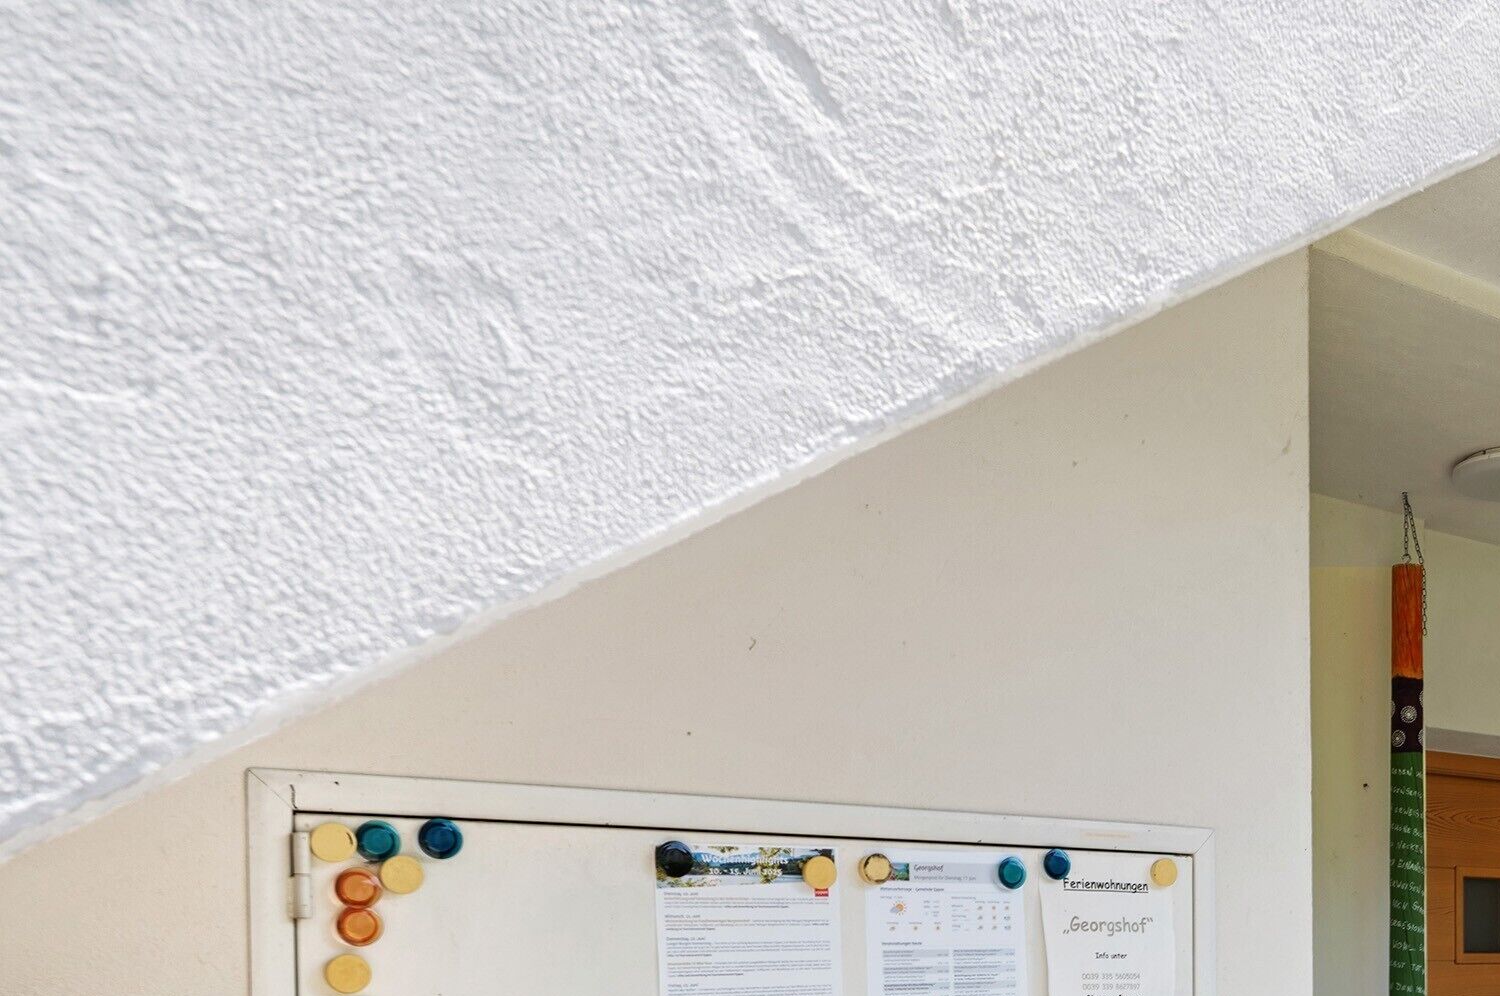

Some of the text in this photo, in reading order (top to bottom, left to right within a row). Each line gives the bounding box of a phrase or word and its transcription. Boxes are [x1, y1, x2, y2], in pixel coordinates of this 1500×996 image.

[702, 853, 789, 867] Wochenhighlights
[1063, 878, 1149, 893] Ferienwohnungen
[1063, 916, 1153, 936] „Georgshof“
[1082, 972, 1099, 980] 0039
